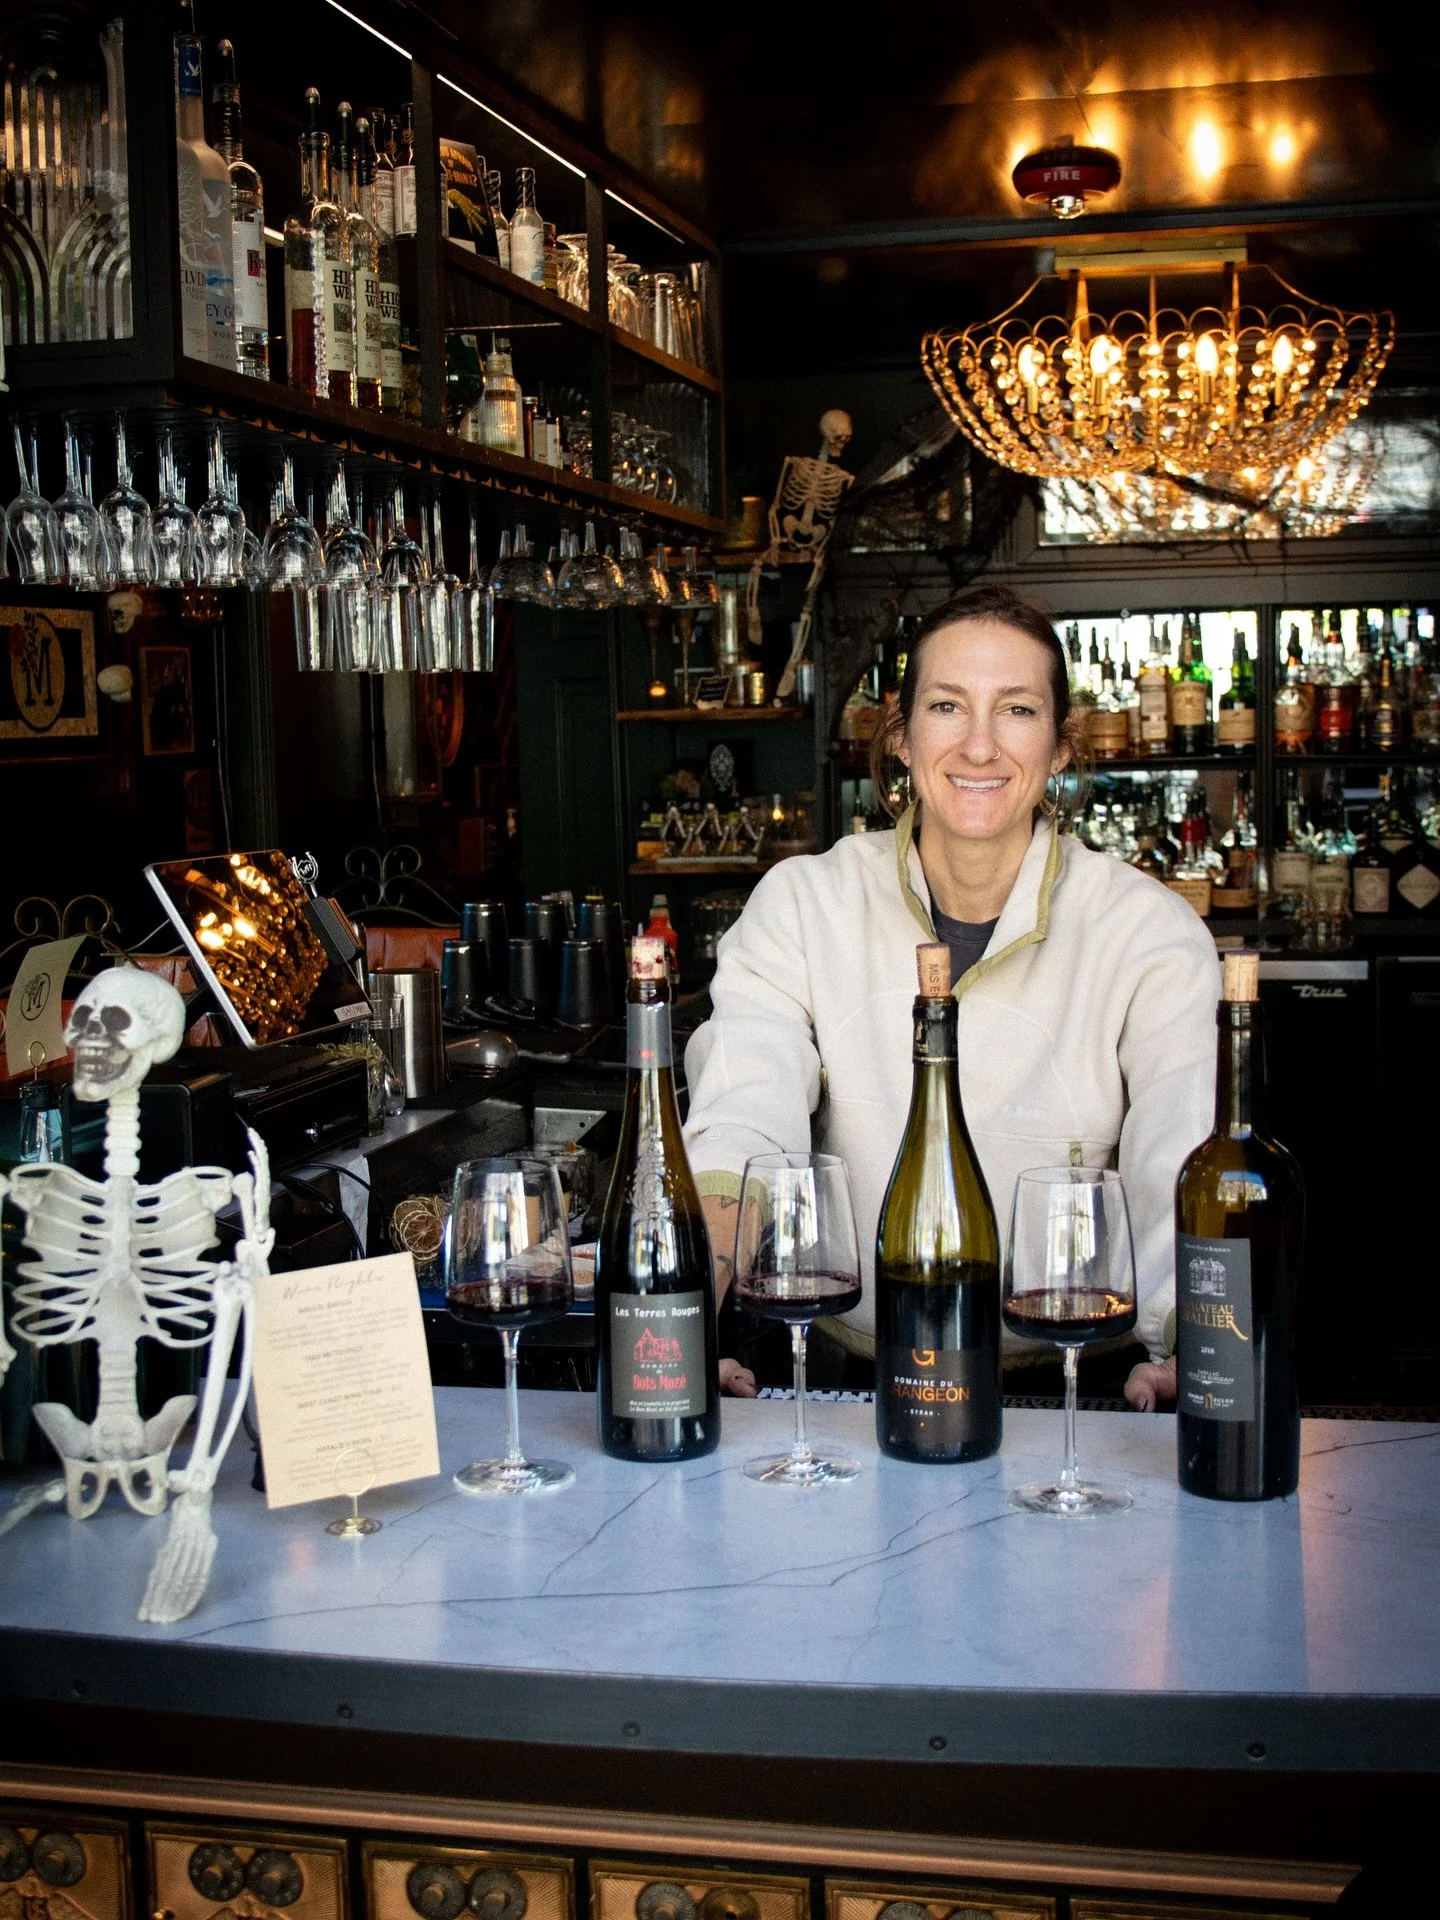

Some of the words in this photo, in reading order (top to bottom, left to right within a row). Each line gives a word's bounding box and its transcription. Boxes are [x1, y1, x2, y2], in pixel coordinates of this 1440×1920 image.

[1043, 170, 1081, 182] FIRE
[929, 963, 939, 983] MIS
[615, 1306, 630, 1317] Les
[634, 1307, 666, 1318] Terres
[671, 1305, 700, 1318] Rouges
[894, 1376, 935, 1387] DOMAINE
[891, 1384, 970, 1402] RANGEON
[910, 1408, 934, 1416] SYRAH
